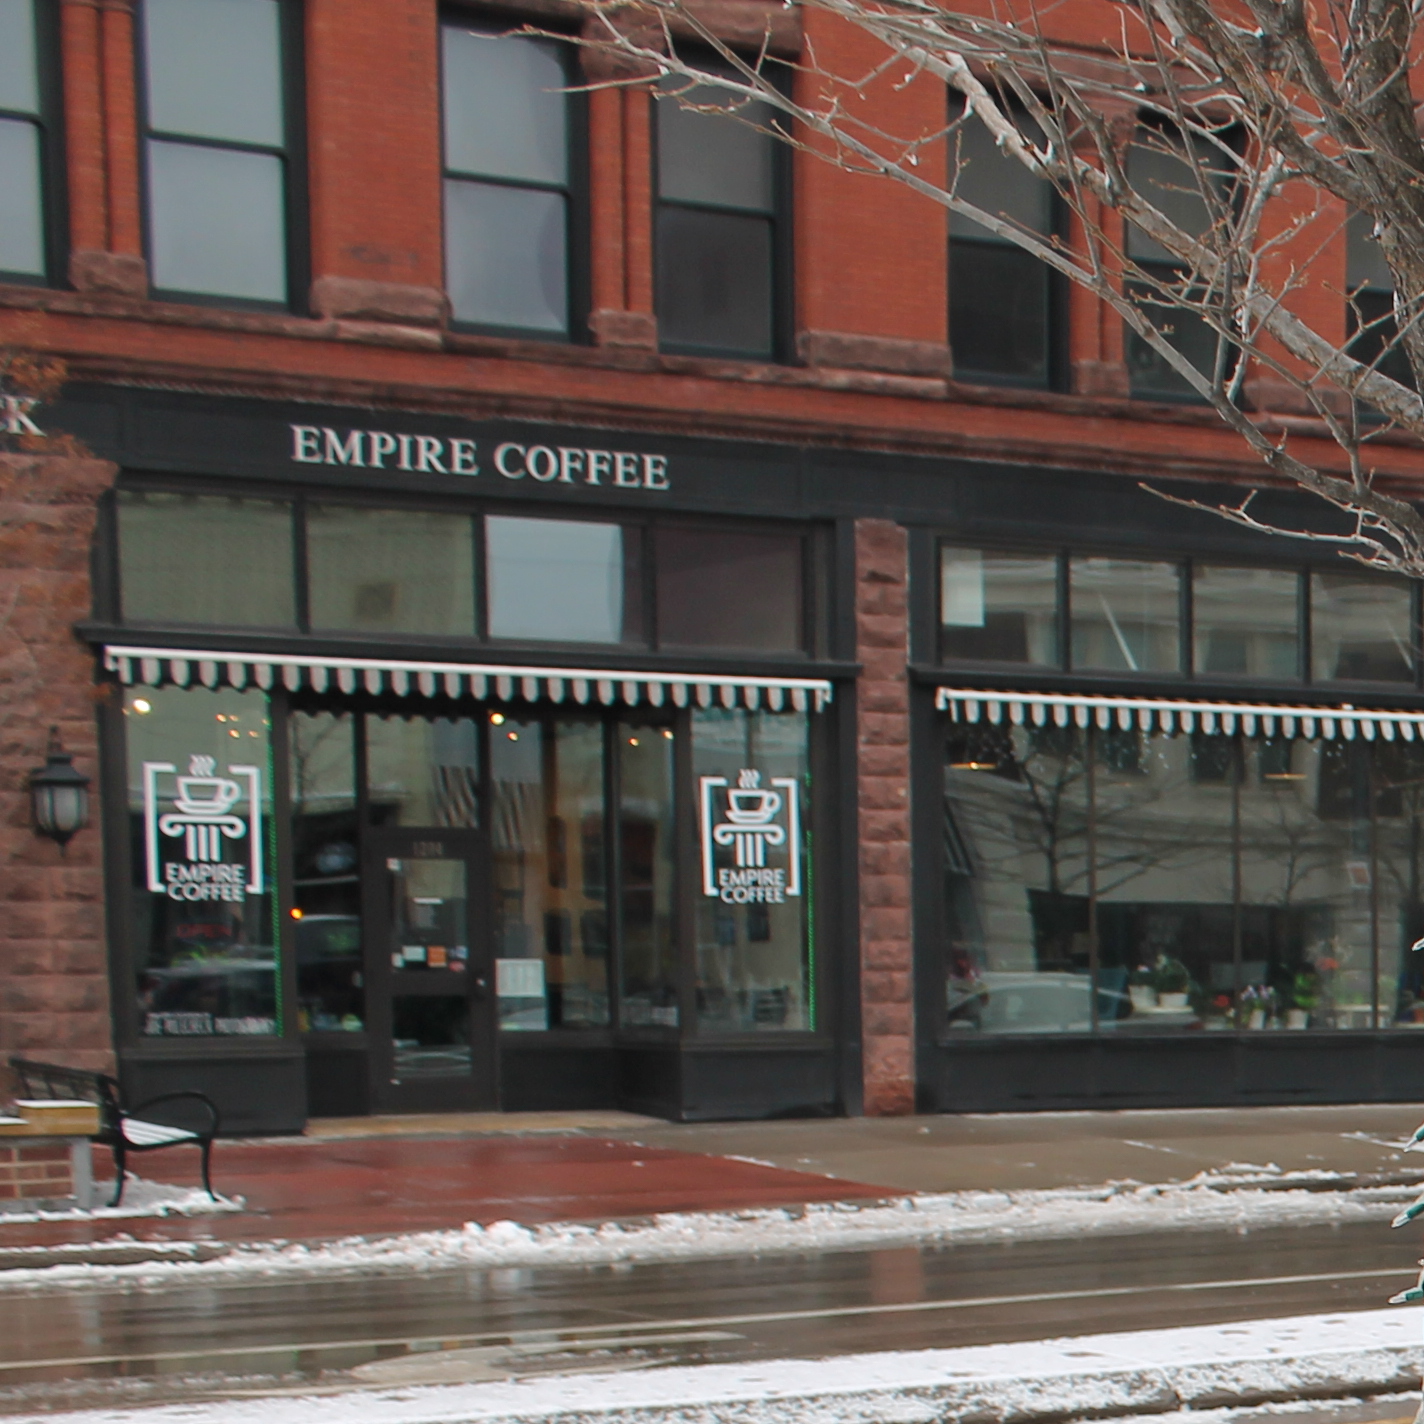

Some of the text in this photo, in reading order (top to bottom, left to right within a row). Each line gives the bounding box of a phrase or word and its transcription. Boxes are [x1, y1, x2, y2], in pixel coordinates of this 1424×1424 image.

[290, 424, 670, 490] EMPIRE COFFEE
[164, 862, 246, 884] EMPIRE
[718, 868, 786, 888] EMPIRE
[167, 882, 246, 902] COFFEE
[720, 886, 786, 904] COFFEE
